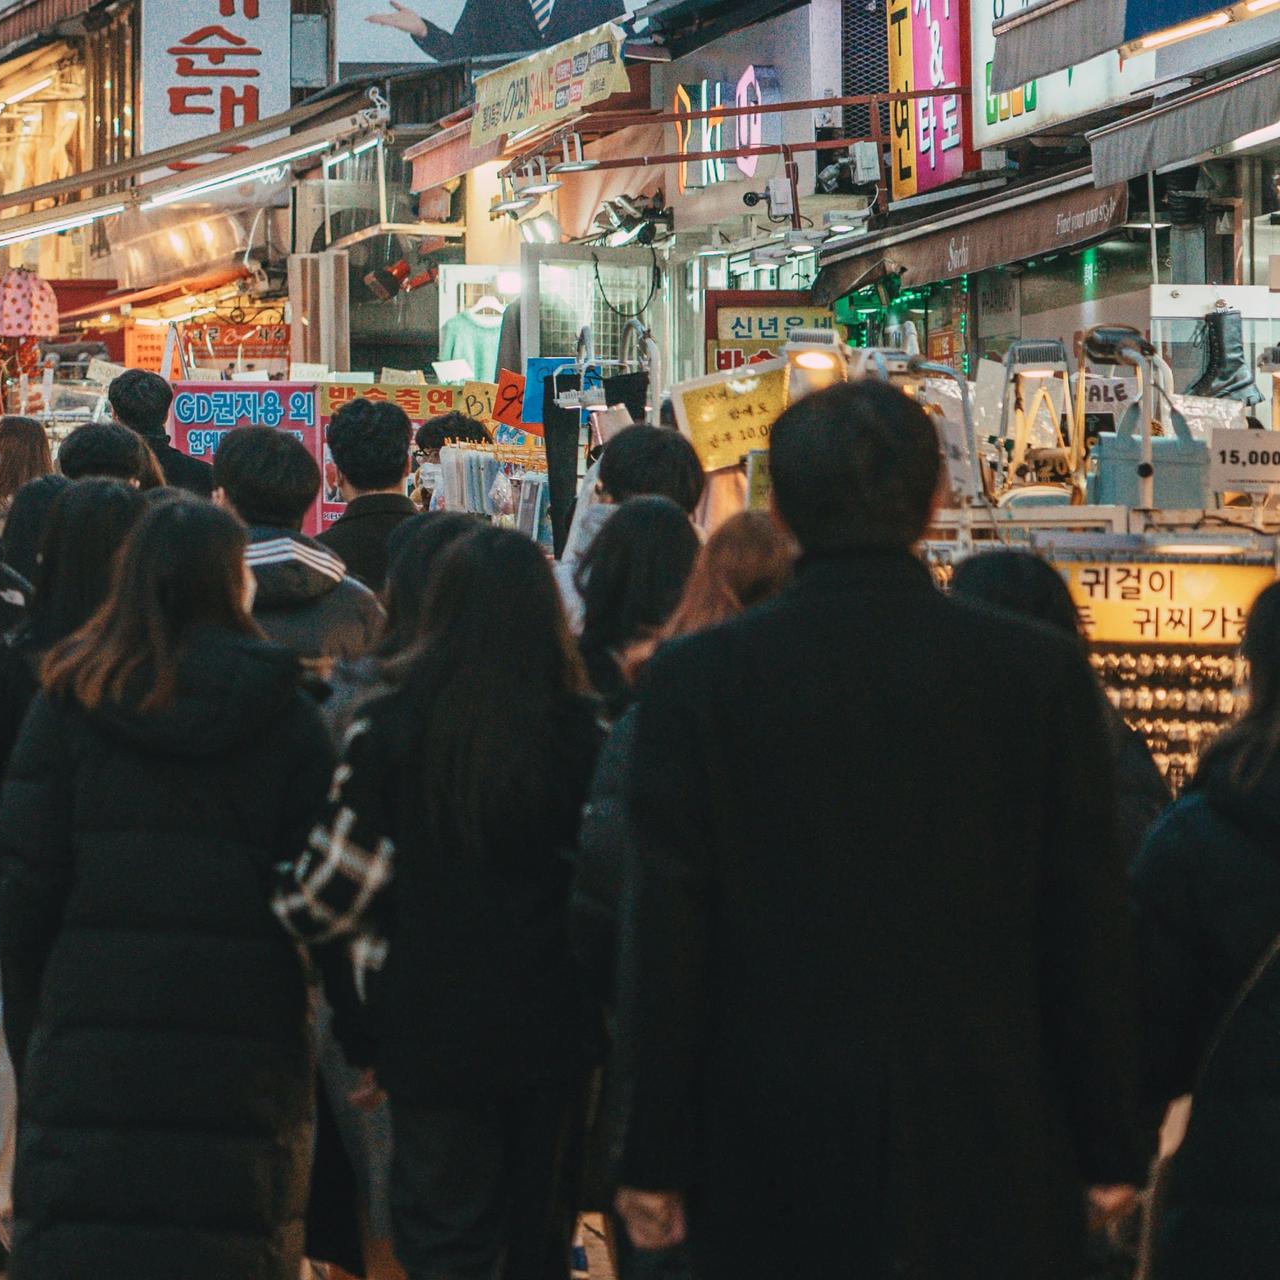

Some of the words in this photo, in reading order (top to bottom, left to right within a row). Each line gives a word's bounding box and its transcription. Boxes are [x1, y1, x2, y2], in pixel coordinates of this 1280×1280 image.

[174, 391, 284, 427] GD권지용
[290, 391, 315, 426] 외
[187, 430, 226, 457] 연예
[1080, 567, 1177, 602] 귀걸이
